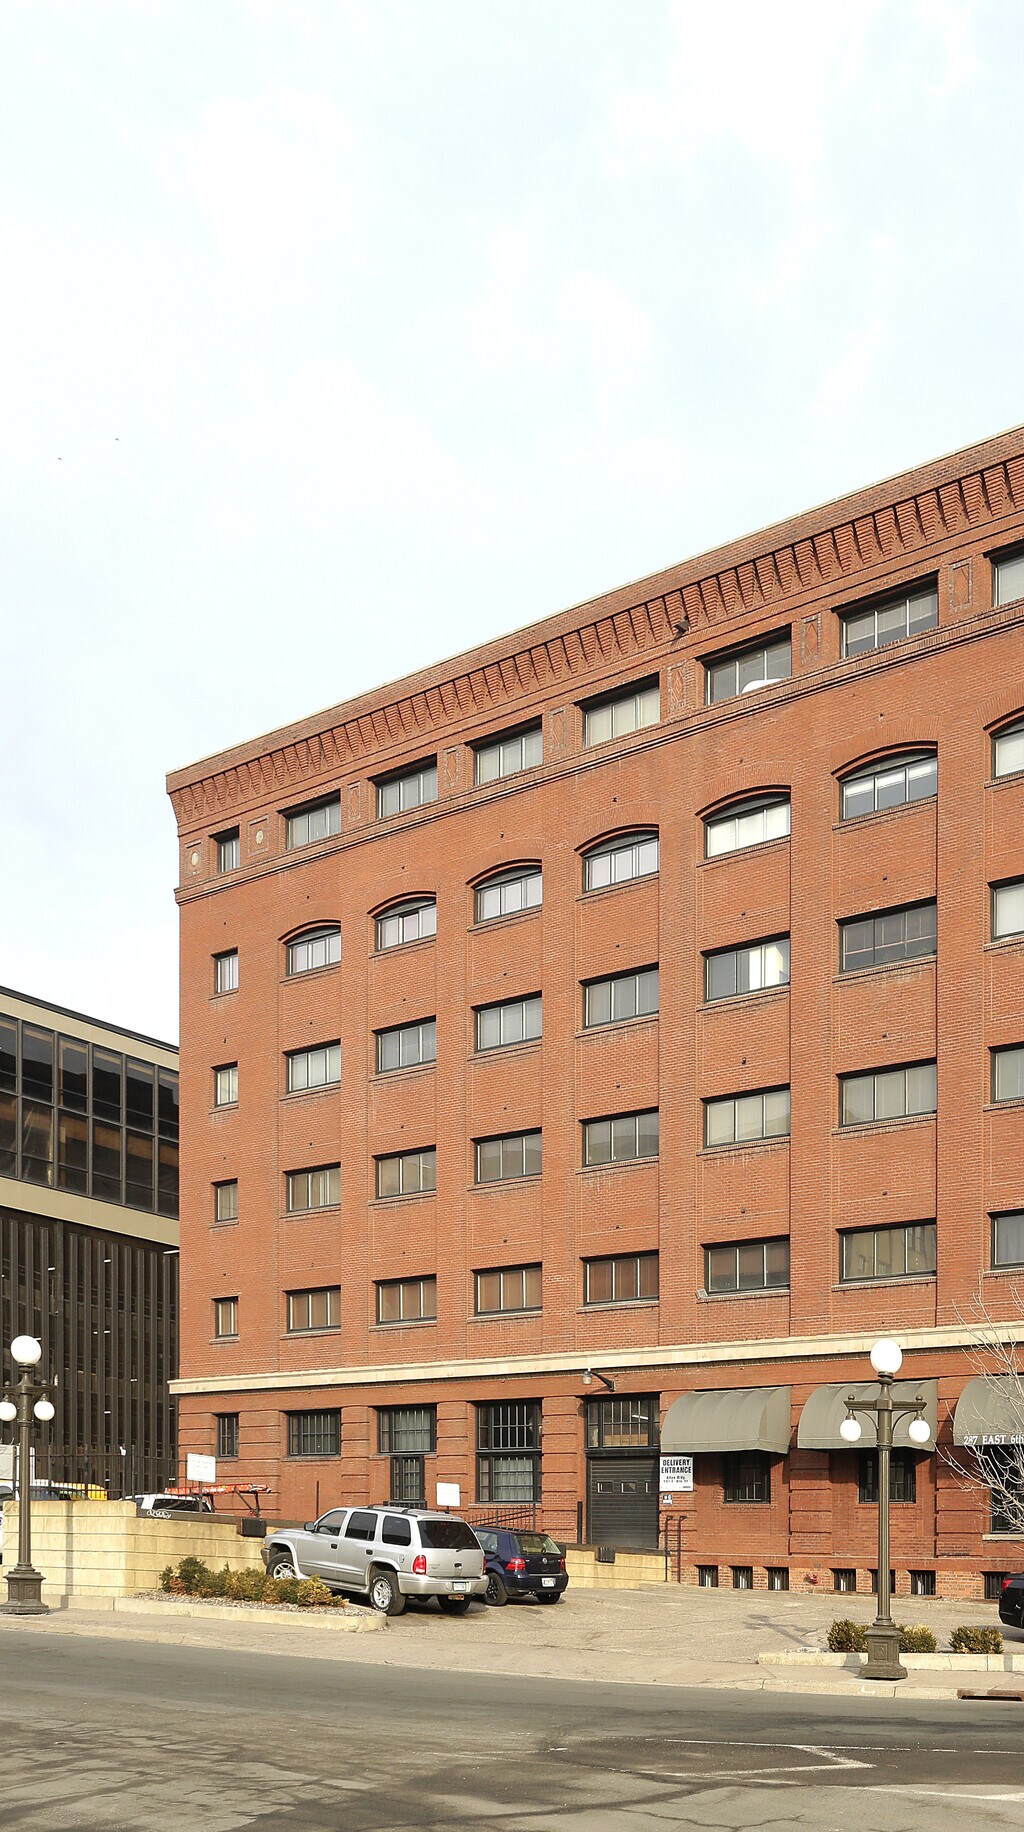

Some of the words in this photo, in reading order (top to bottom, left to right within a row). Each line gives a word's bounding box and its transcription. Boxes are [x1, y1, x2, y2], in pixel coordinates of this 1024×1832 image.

[963, 1435, 978, 1446] 287
[982, 1434, 1006, 1445] EAST
[1010, 1433, 1024, 1444] 6th
